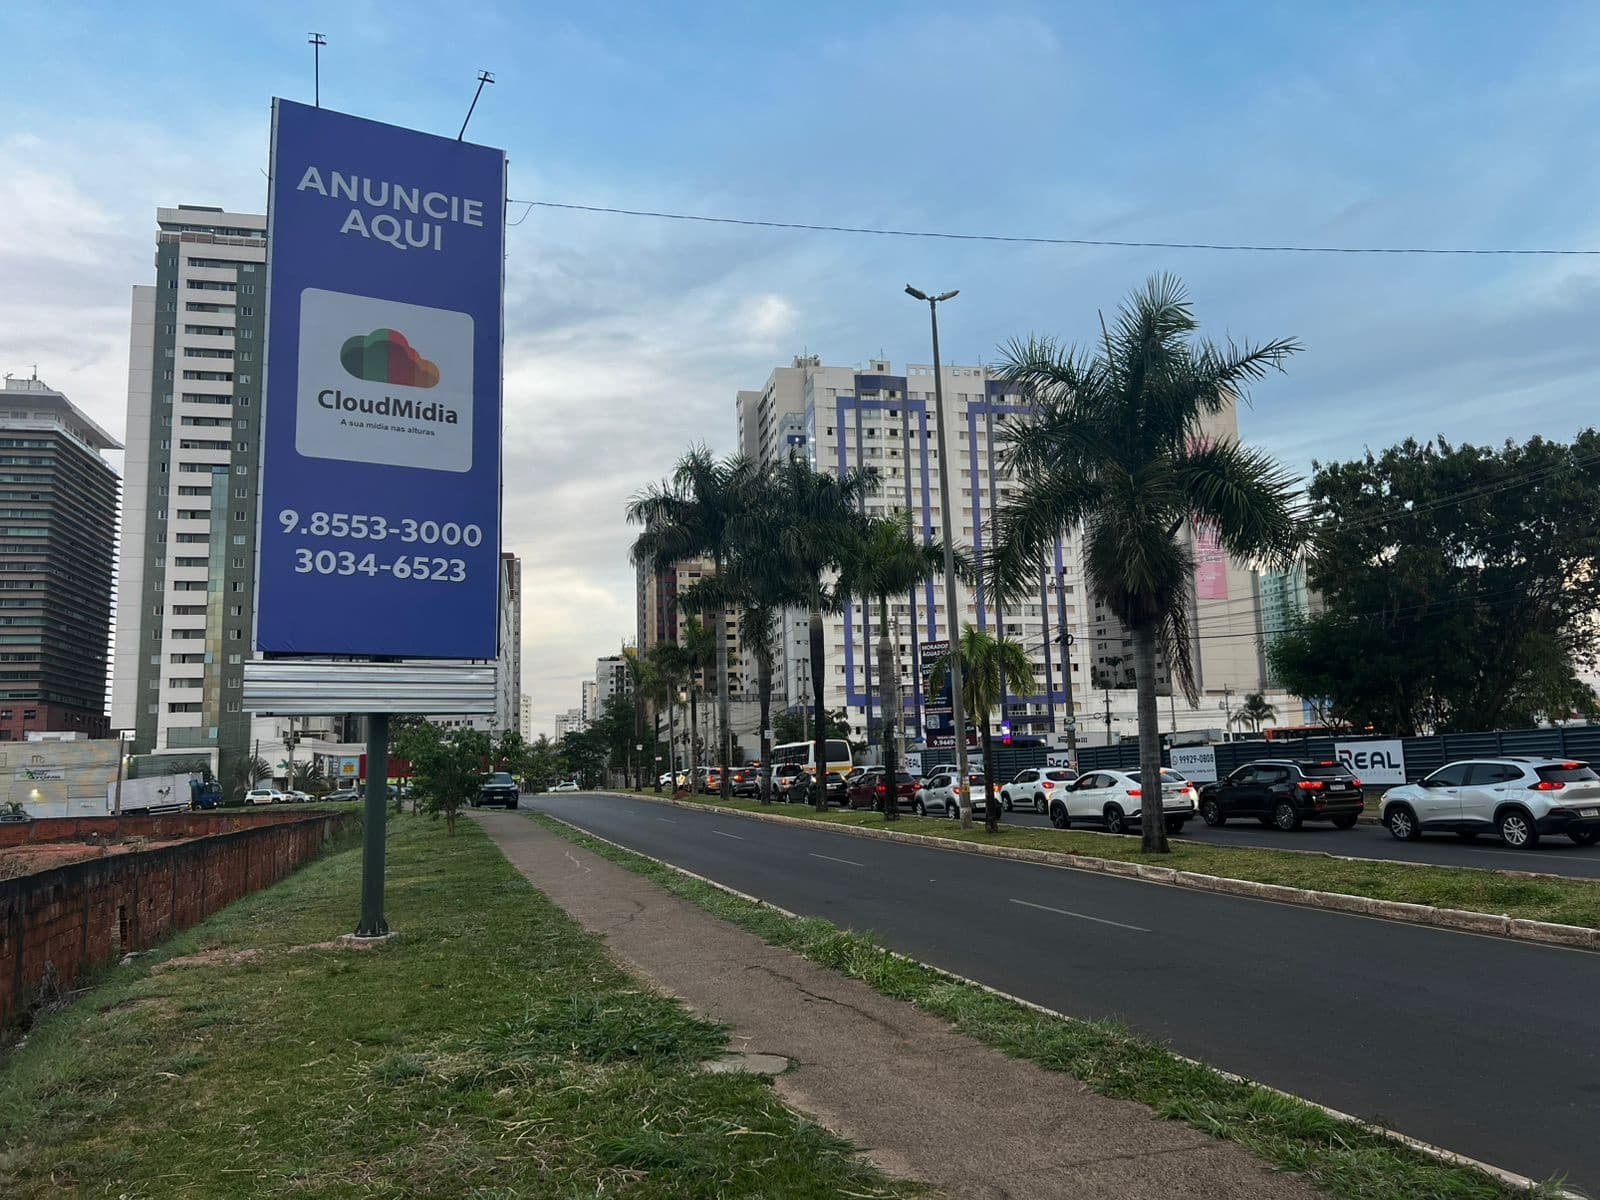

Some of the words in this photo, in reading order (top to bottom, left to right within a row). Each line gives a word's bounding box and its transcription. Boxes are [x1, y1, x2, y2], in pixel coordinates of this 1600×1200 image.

[296, 166, 483, 227] ANUNCIE
[340, 208, 442, 251] AQUI
[318, 389, 458, 424] CloudMídia
[341, 418, 347, 426] A
[349, 420, 364, 428] sua
[390, 425, 405, 433] nas
[407, 427, 435, 436] alturas
[279, 509, 482, 547] 9.8553-3000
[295, 548, 467, 582] 3034-6523
[1338, 749, 1401, 770] REAL
